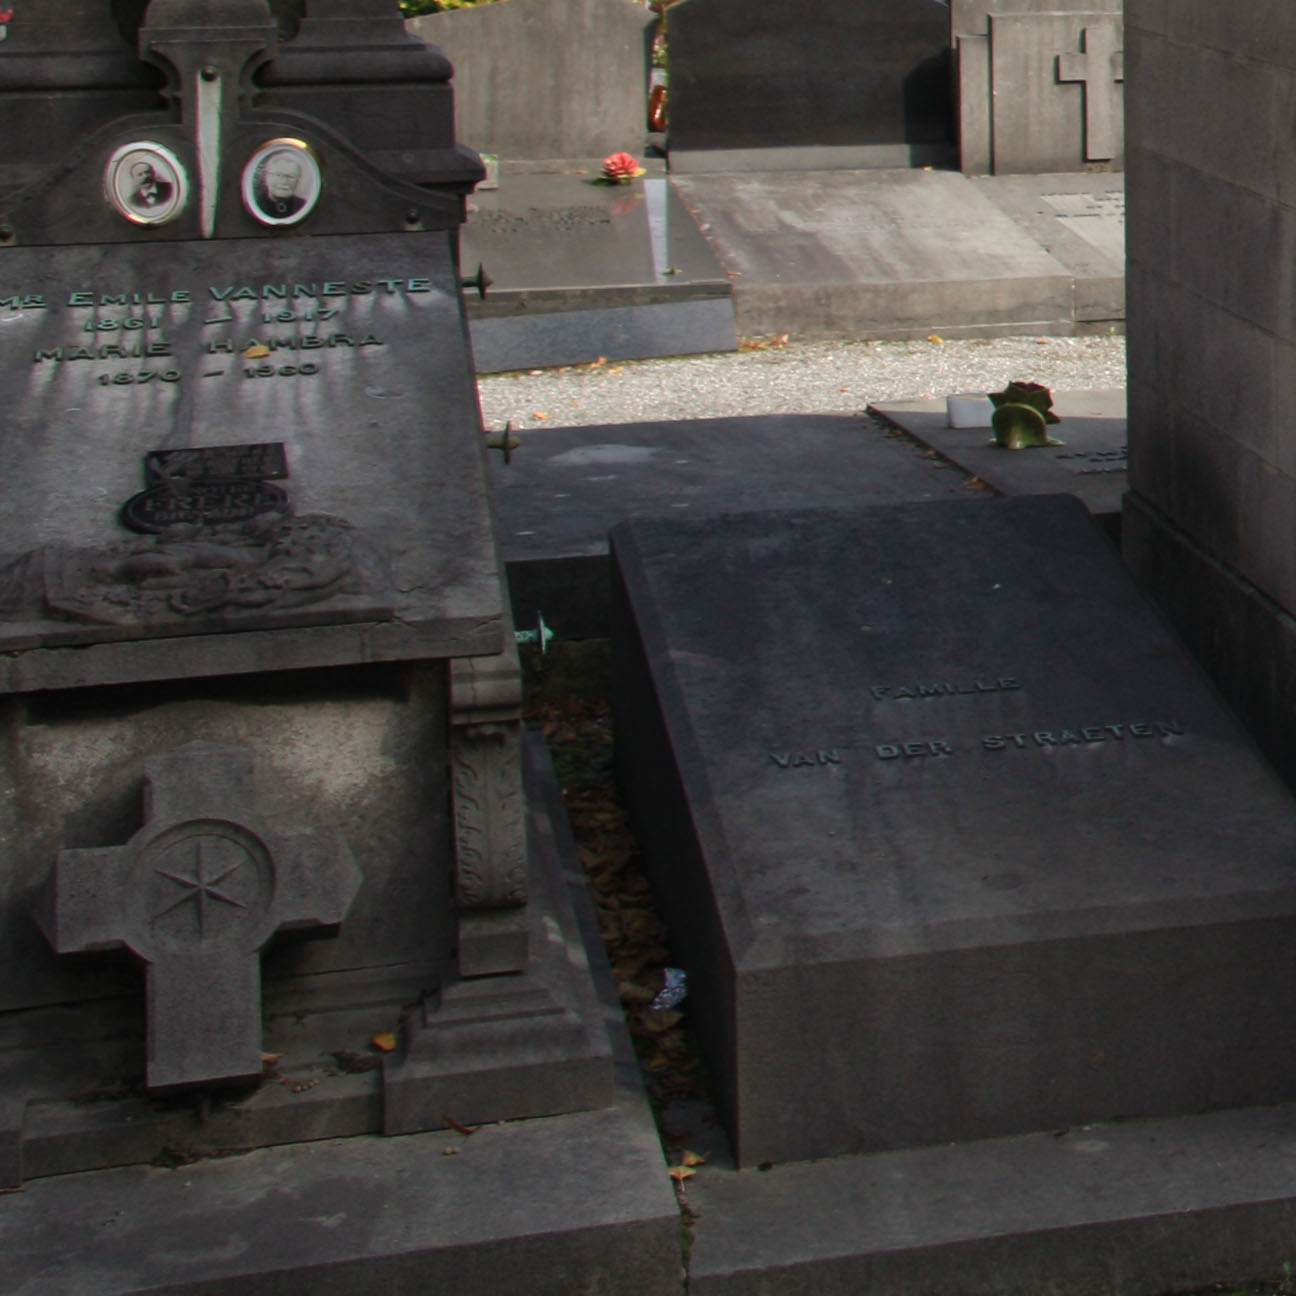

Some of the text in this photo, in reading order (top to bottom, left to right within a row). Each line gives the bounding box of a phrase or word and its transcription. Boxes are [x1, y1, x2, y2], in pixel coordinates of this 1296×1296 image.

[68, 290, 192, 307] EMILE
[208, 277, 432, 302] VANNESTE
[83, 317, 160, 333] 1861
[263, 309, 339, 324] 1917
[34, 334, 385, 363] MARIE HAMBRA
[97, 370, 182, 387] 1870
[243, 363, 321, 379] 1960
[868, 676, 1022, 703] FAMILLE
[769, 719, 1187, 770] VAN DER STRAETEN
